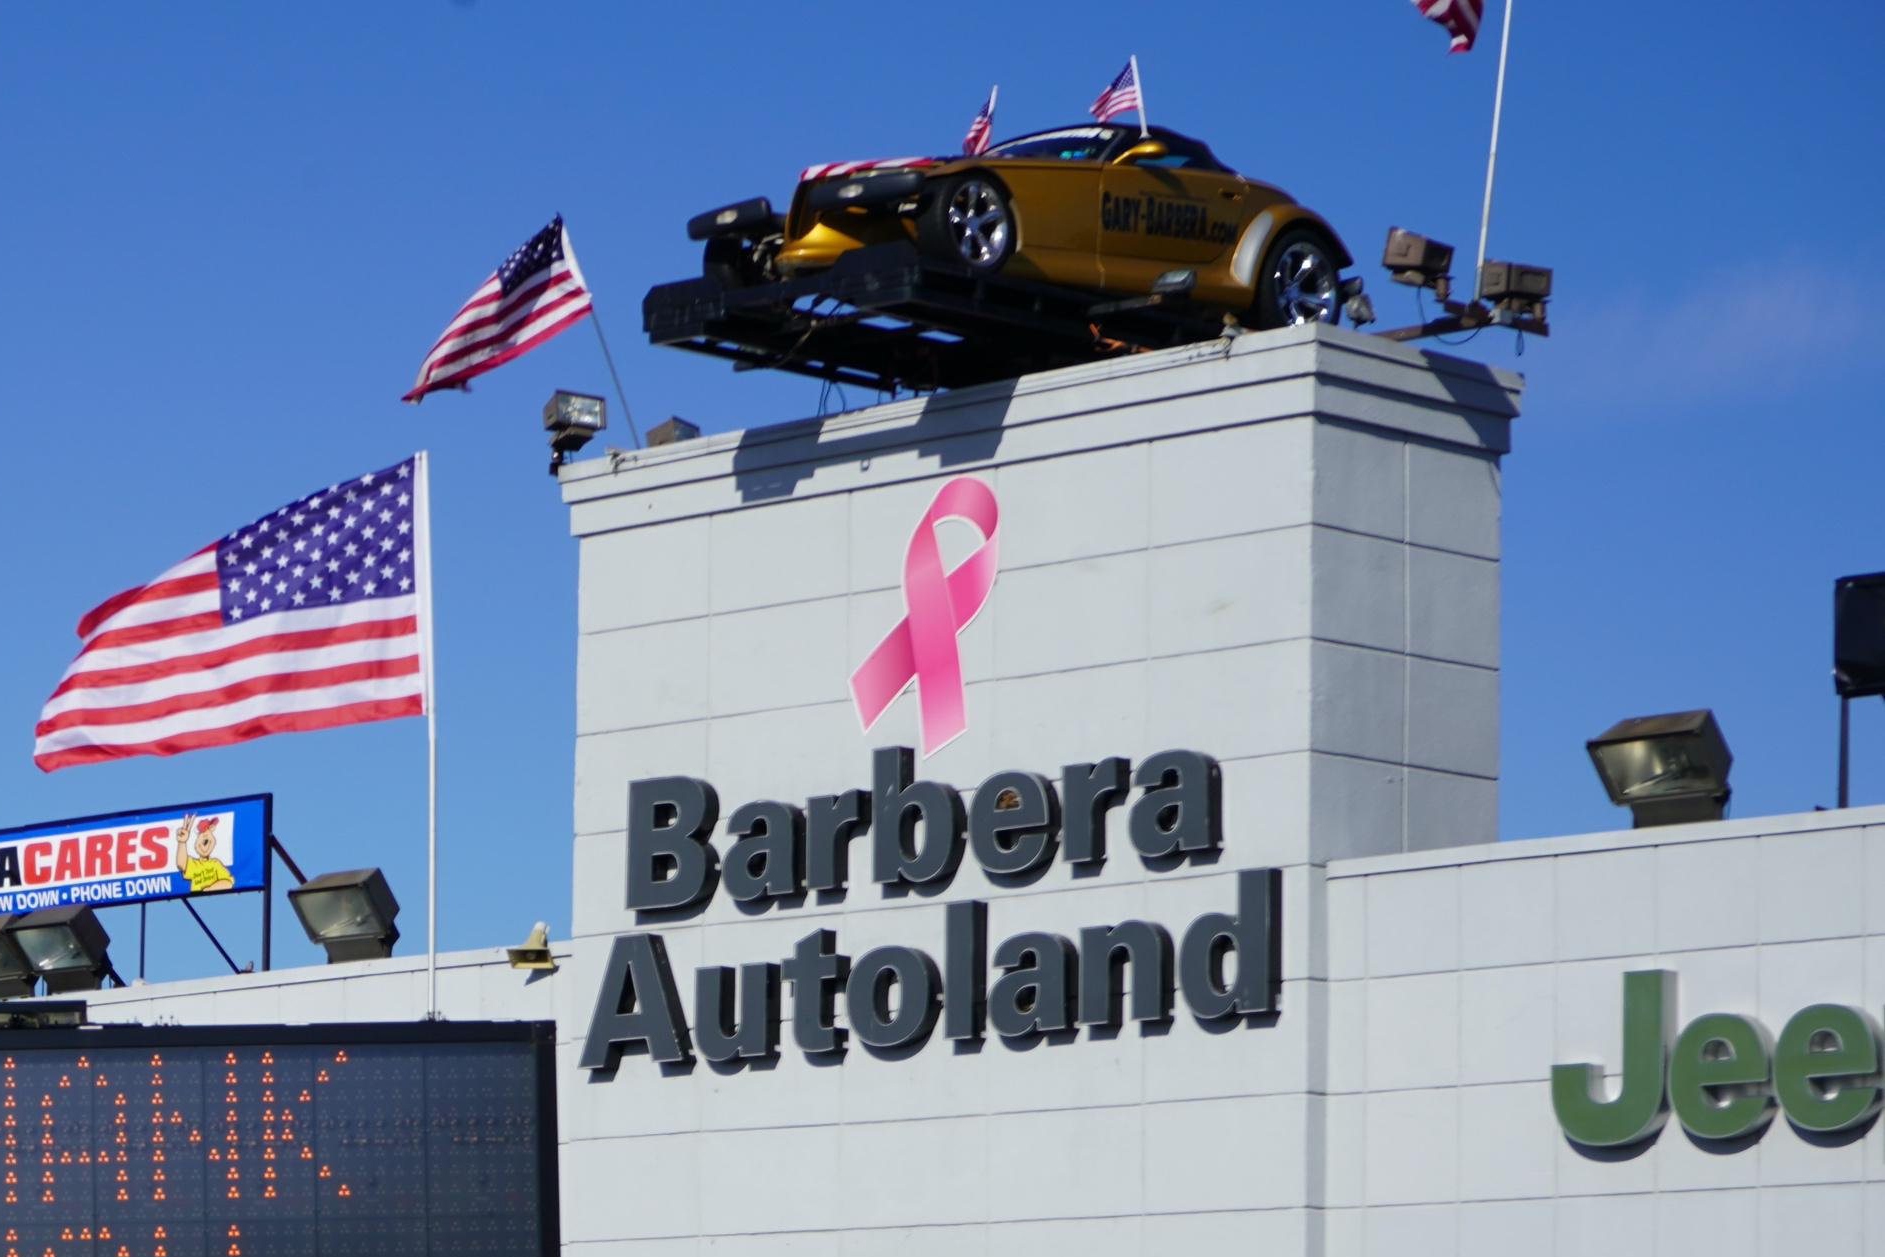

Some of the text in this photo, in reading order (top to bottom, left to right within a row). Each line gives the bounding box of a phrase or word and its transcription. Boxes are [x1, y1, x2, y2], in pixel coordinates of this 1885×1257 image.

[17, 890, 59, 910] DOWN
[71, 880, 122, 903] PHONE
[125, 875, 171, 897] DOWN
[625, 746, 1224, 922] Barbera
[578, 868, 1282, 1080] Autoland
[1551, 968, 1885, 1160] Jee
